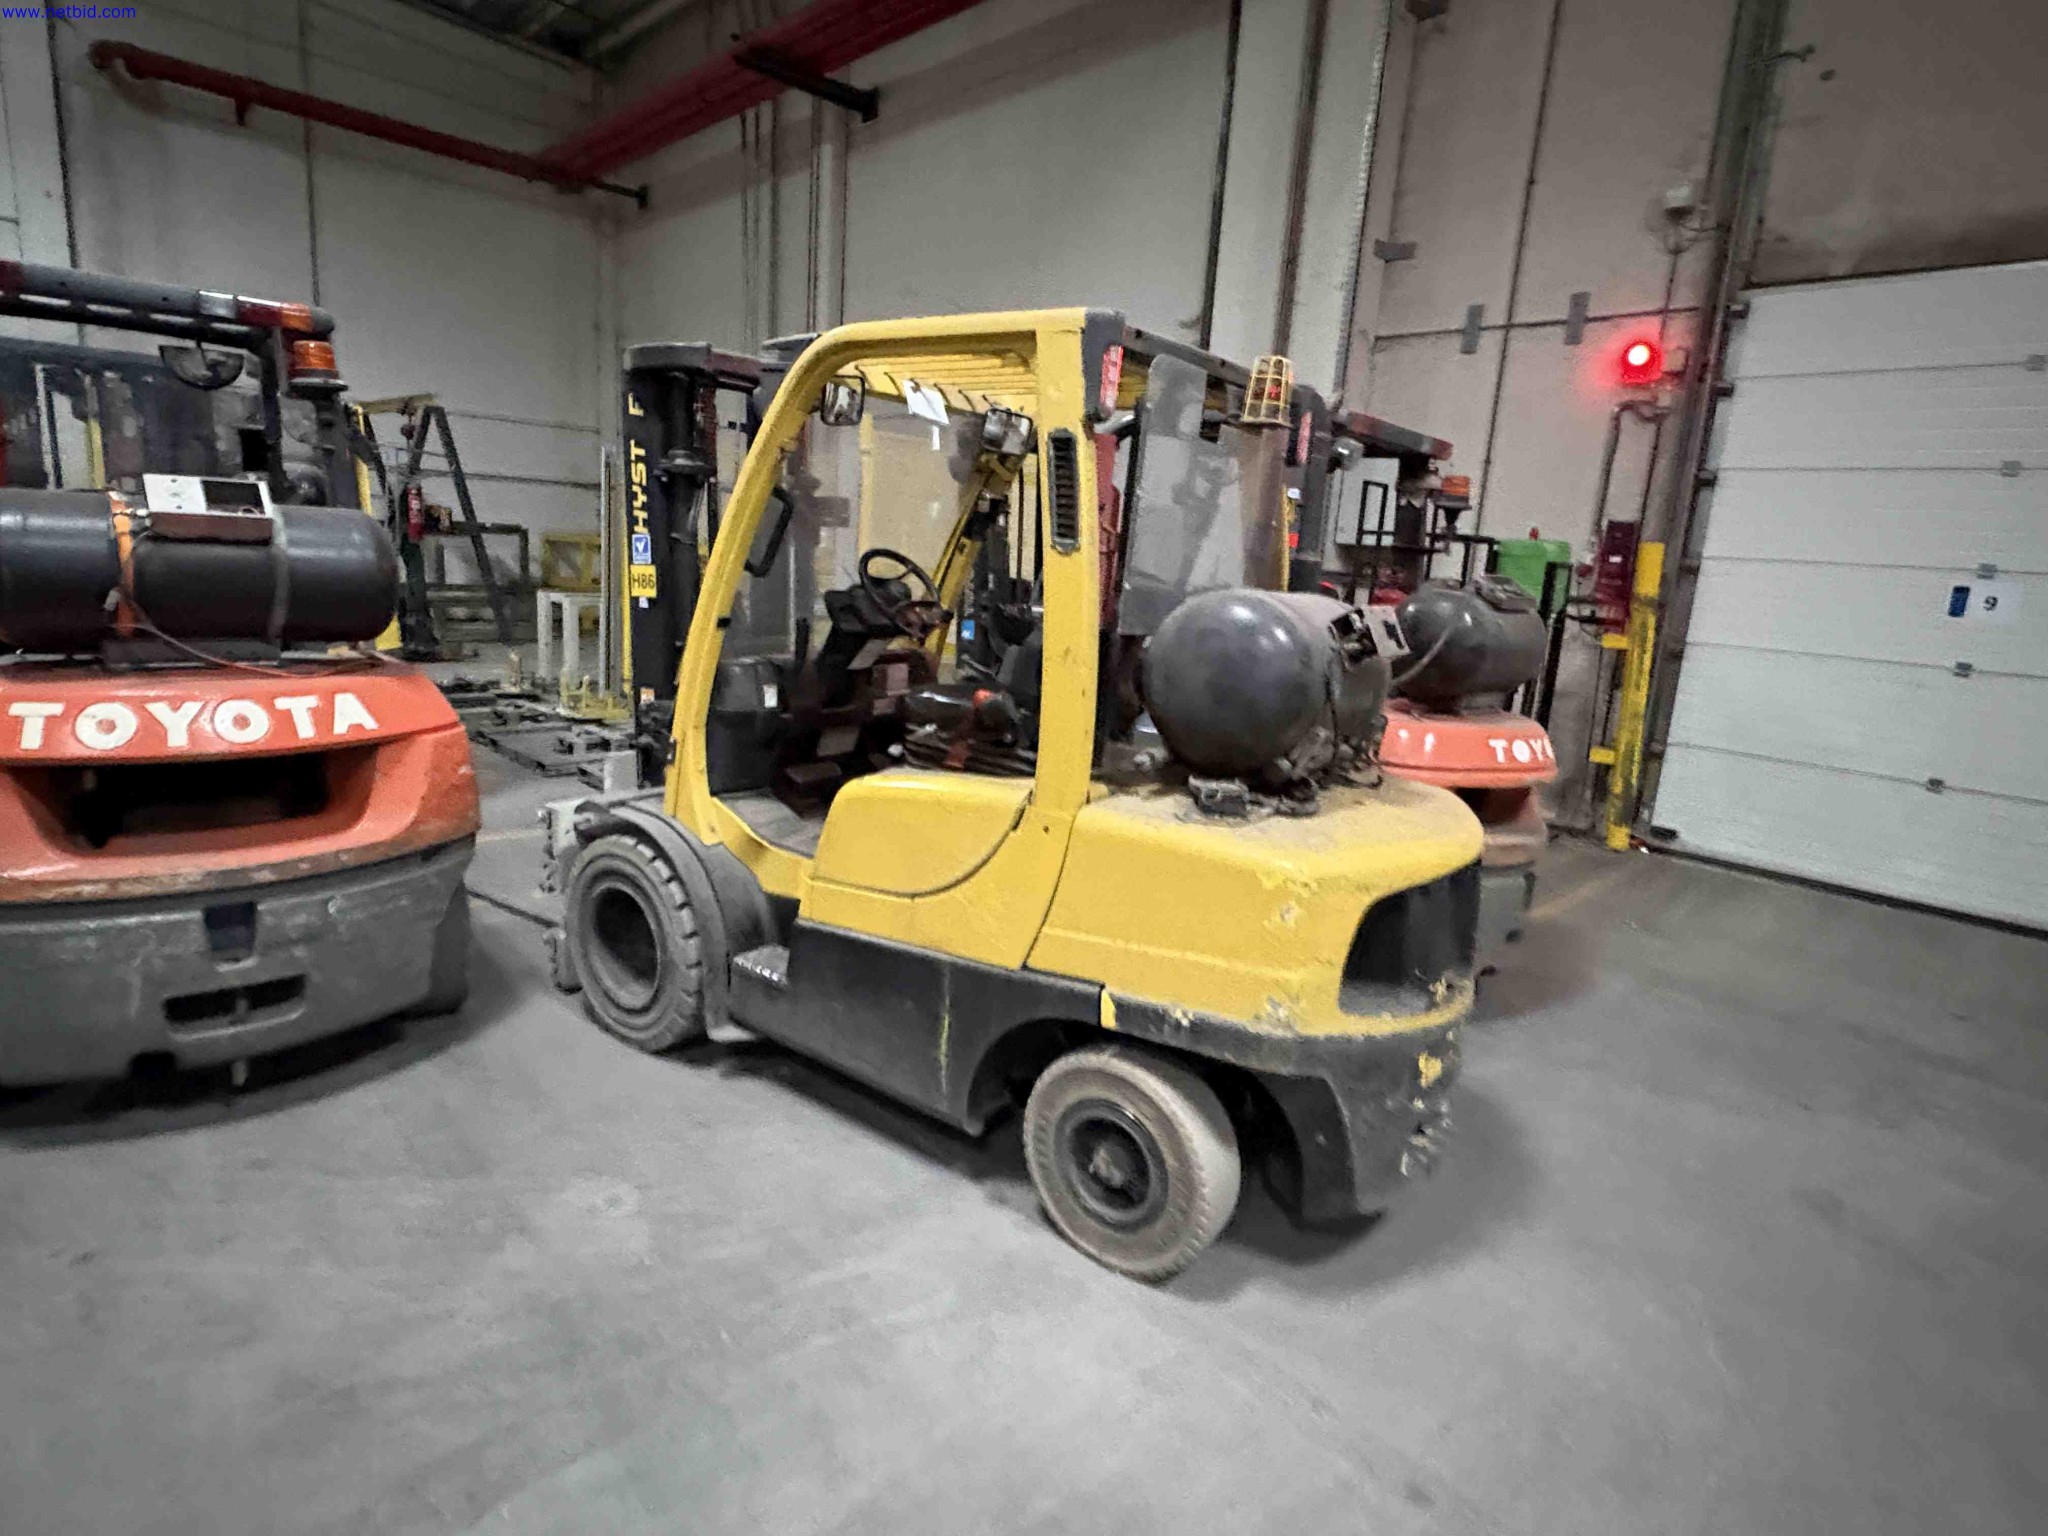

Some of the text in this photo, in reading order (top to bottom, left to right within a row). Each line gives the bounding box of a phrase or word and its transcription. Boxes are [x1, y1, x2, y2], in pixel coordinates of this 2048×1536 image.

[631, 573, 655, 590] H86
[1983, 595, 1999, 612] 9
[8, 692, 379, 750] TOYOTA
